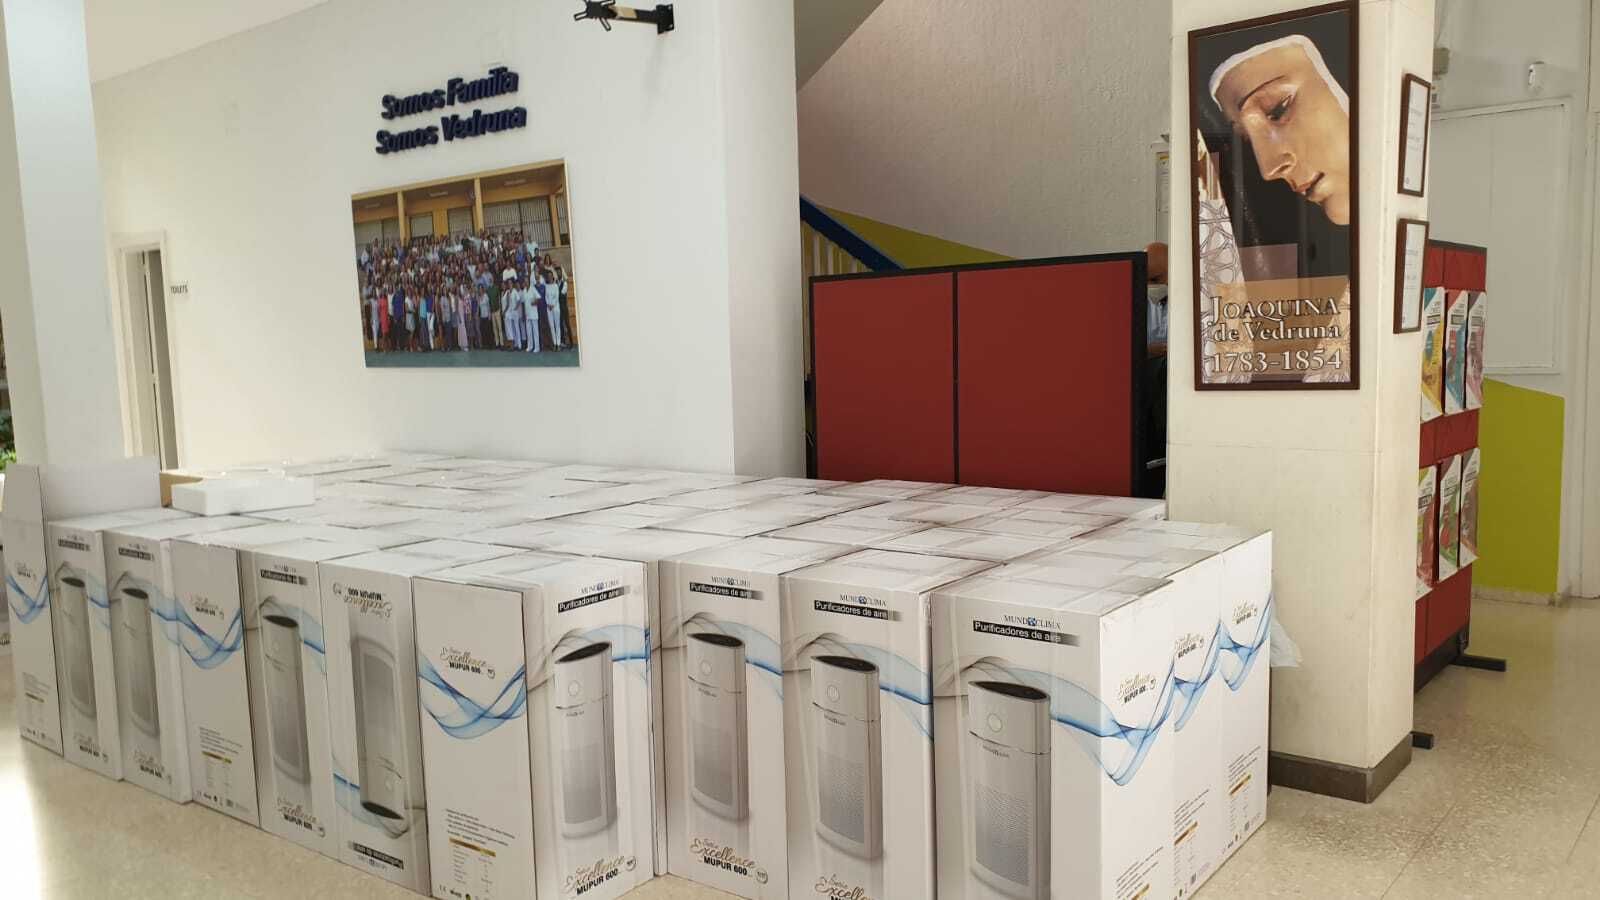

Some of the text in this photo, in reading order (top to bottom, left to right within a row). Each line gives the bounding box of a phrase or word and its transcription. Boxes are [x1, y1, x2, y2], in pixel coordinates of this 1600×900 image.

[381, 89, 446, 120] Somos
[375, 106, 527, 154] Somos Vedruna
[1207, 296, 1341, 326] JOAQUINA
[1213, 320, 1341, 342] de Vedruna
[1211, 349, 1344, 373] 1783-1854
[690, 583, 730, 596] Purificadores
[730, 588, 739, 596] de
[559, 594, 599, 611] Purificadores
[599, 592, 607, 600] de
[815, 601, 888, 620] Purificadores de aire
[975, 621, 1062, 643] Purificadores de aire
[703, 855, 732, 872] MUPUR
[733, 864, 748, 876] 600
[576, 867, 619, 896] MUPUR 600
